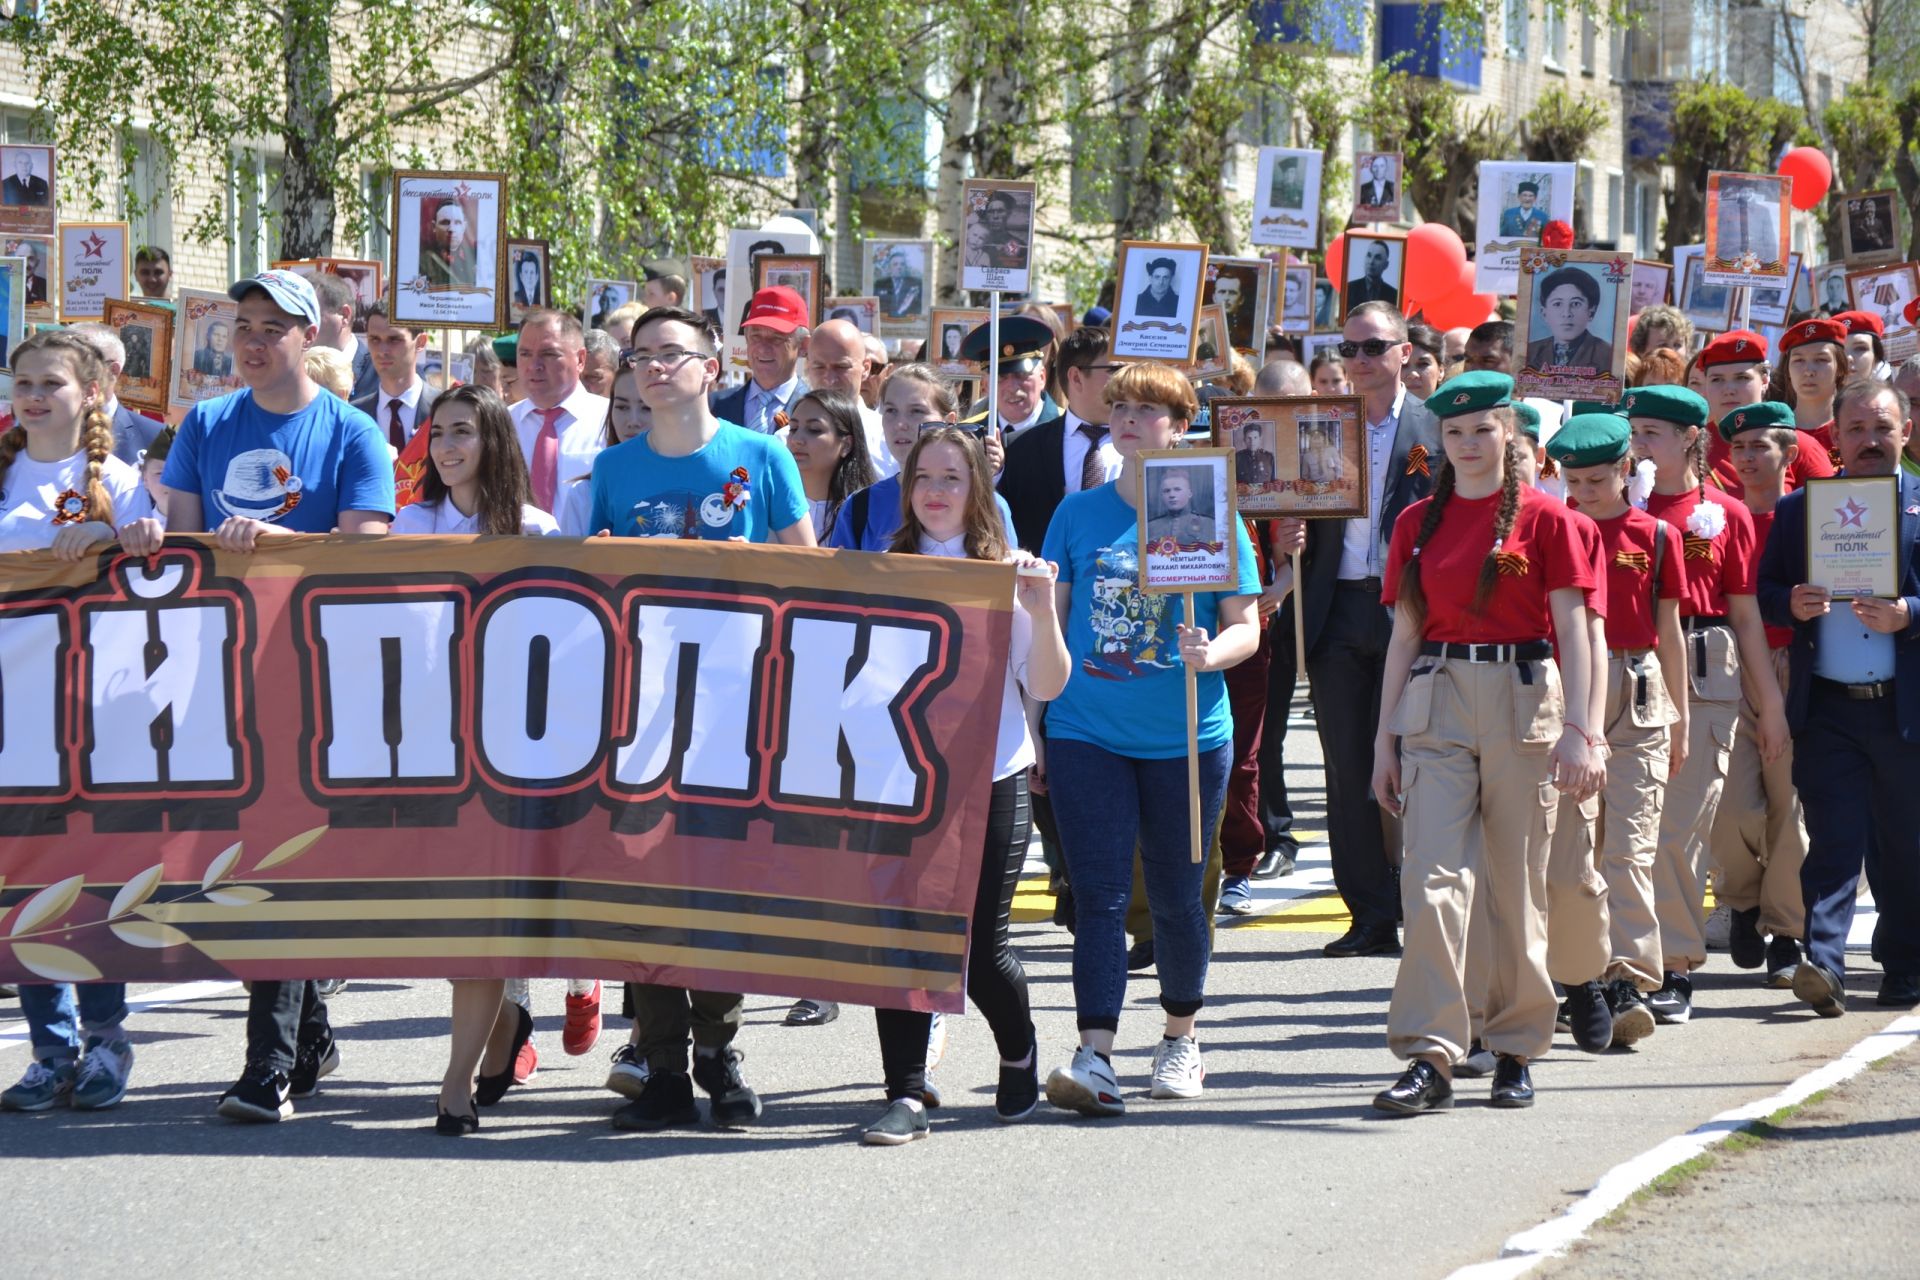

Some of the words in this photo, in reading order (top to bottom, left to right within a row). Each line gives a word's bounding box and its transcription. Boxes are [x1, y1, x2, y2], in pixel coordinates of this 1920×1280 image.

[470, 192, 493, 200] ПОЛК
[81, 267, 103, 275] ПОЛК
[1149, 341, 1187, 349] Семенович
[1834, 542, 1869, 552] ПОЛК
[318, 595, 933, 807] ПОЛК
